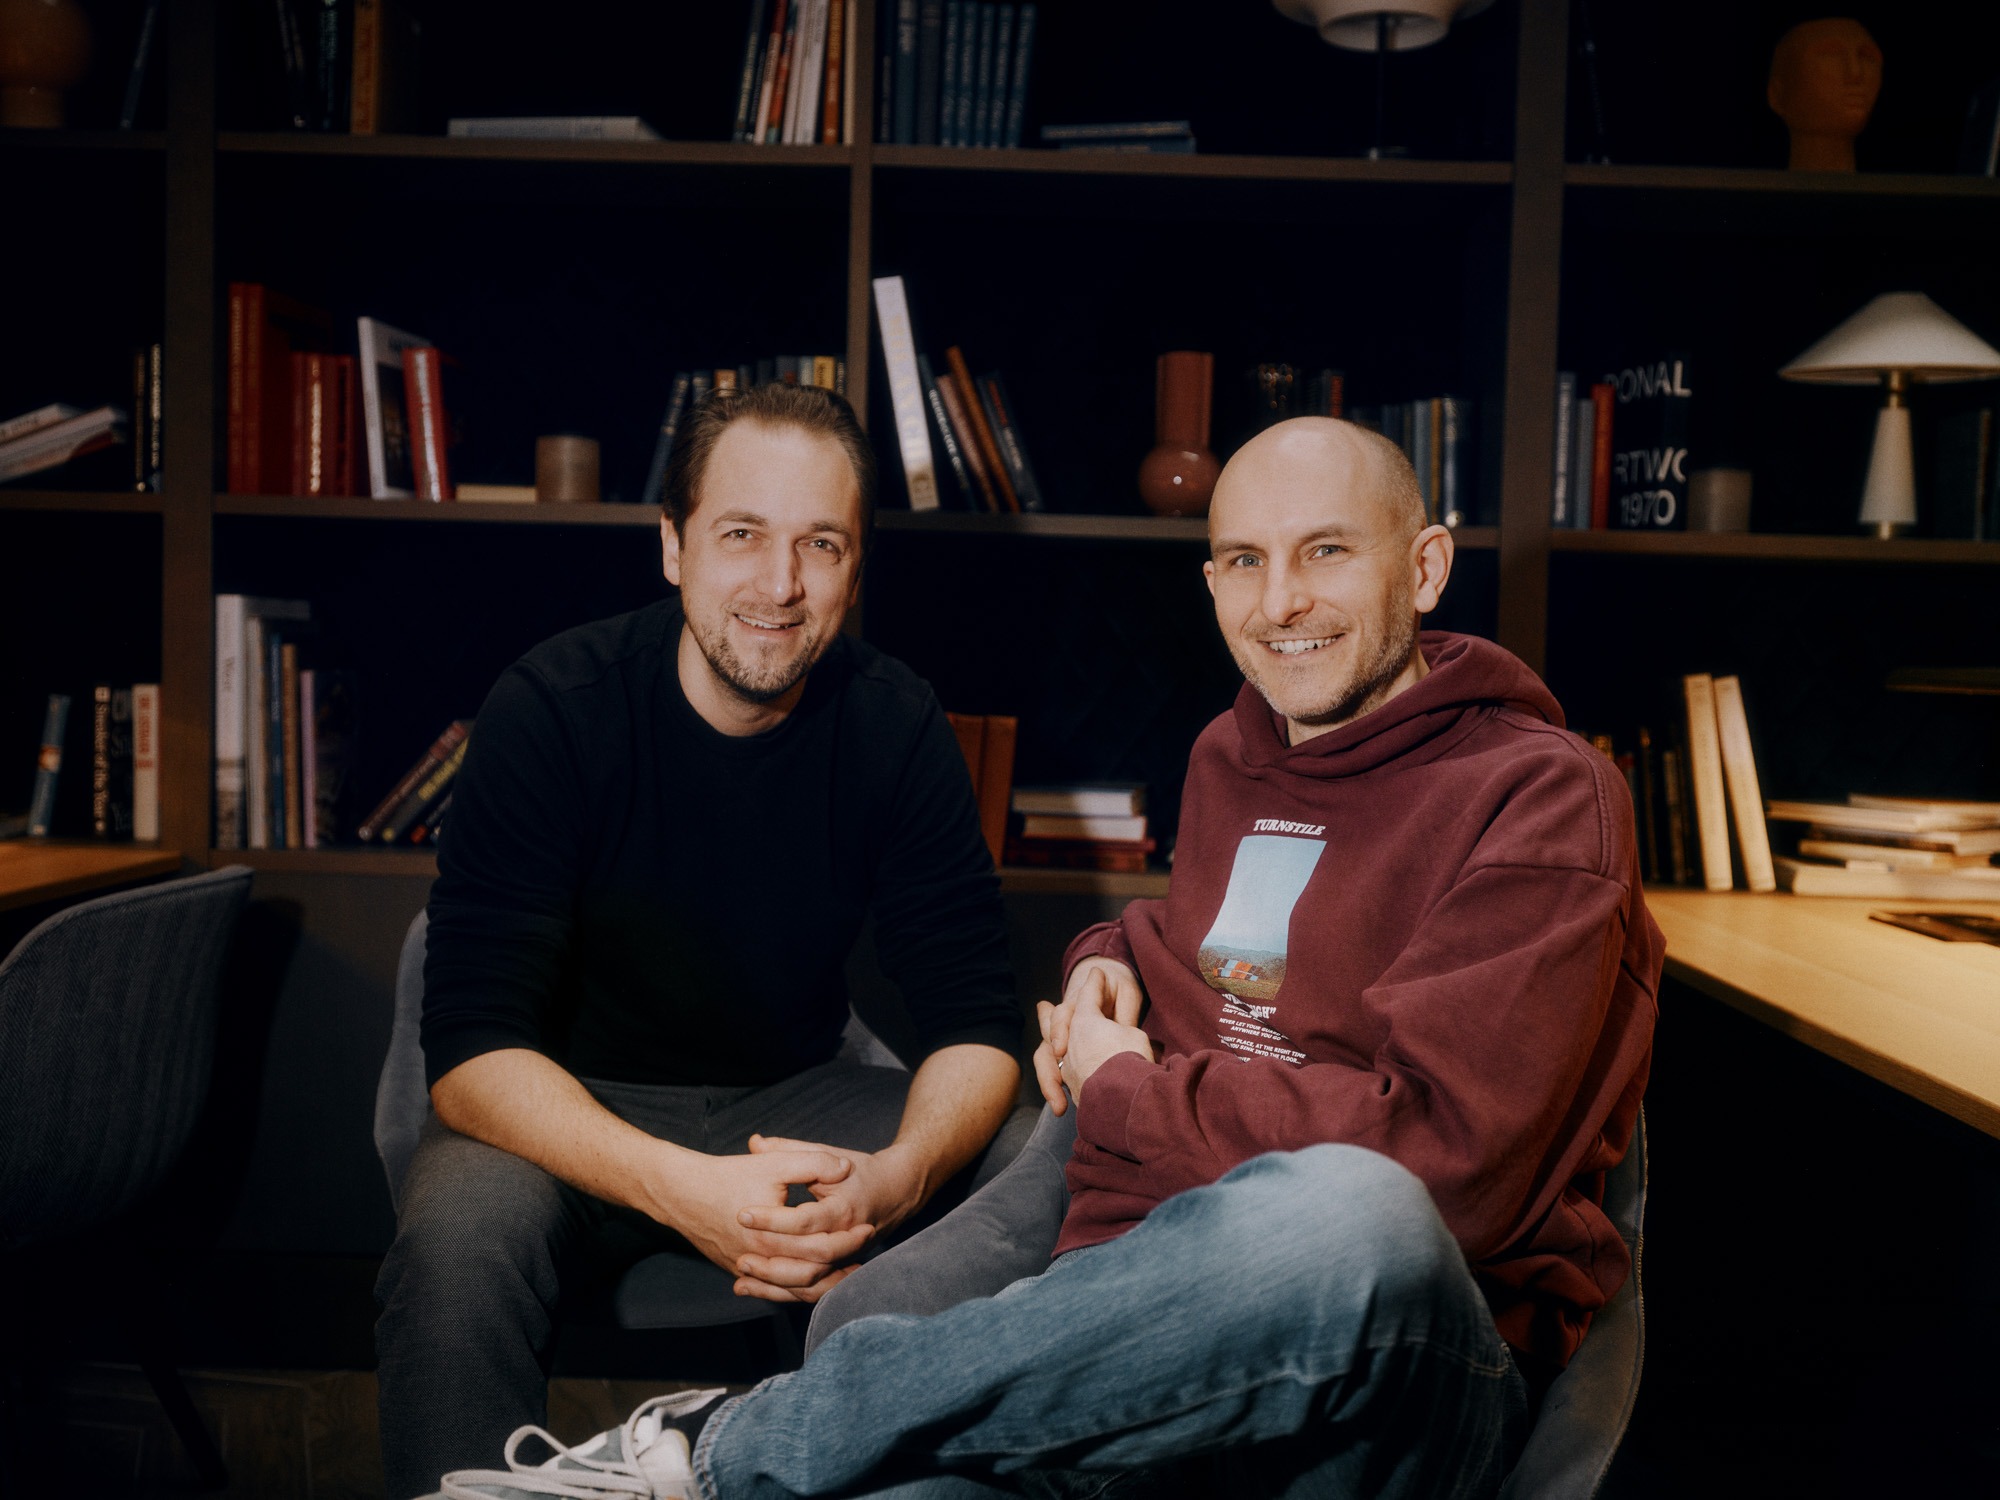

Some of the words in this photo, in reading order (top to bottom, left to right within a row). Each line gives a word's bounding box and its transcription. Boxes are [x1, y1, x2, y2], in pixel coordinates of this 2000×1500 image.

[1619, 488, 1677, 526] 1970
[94, 703, 109, 753] Sneaker
[1253, 819, 1326, 835] TURNSTILE
[1231, 1026, 1260, 1036] ANYWHERE
[1246, 1023, 1261, 1031] YOUR
[1236, 1038, 1254, 1047] PLACE,
[1274, 1047, 1292, 1055] RIGHT
[1291, 1050, 1306, 1059] TIME
[1240, 1045, 1254, 1053] SINK
[1255, 1049, 1269, 1057] INTO
